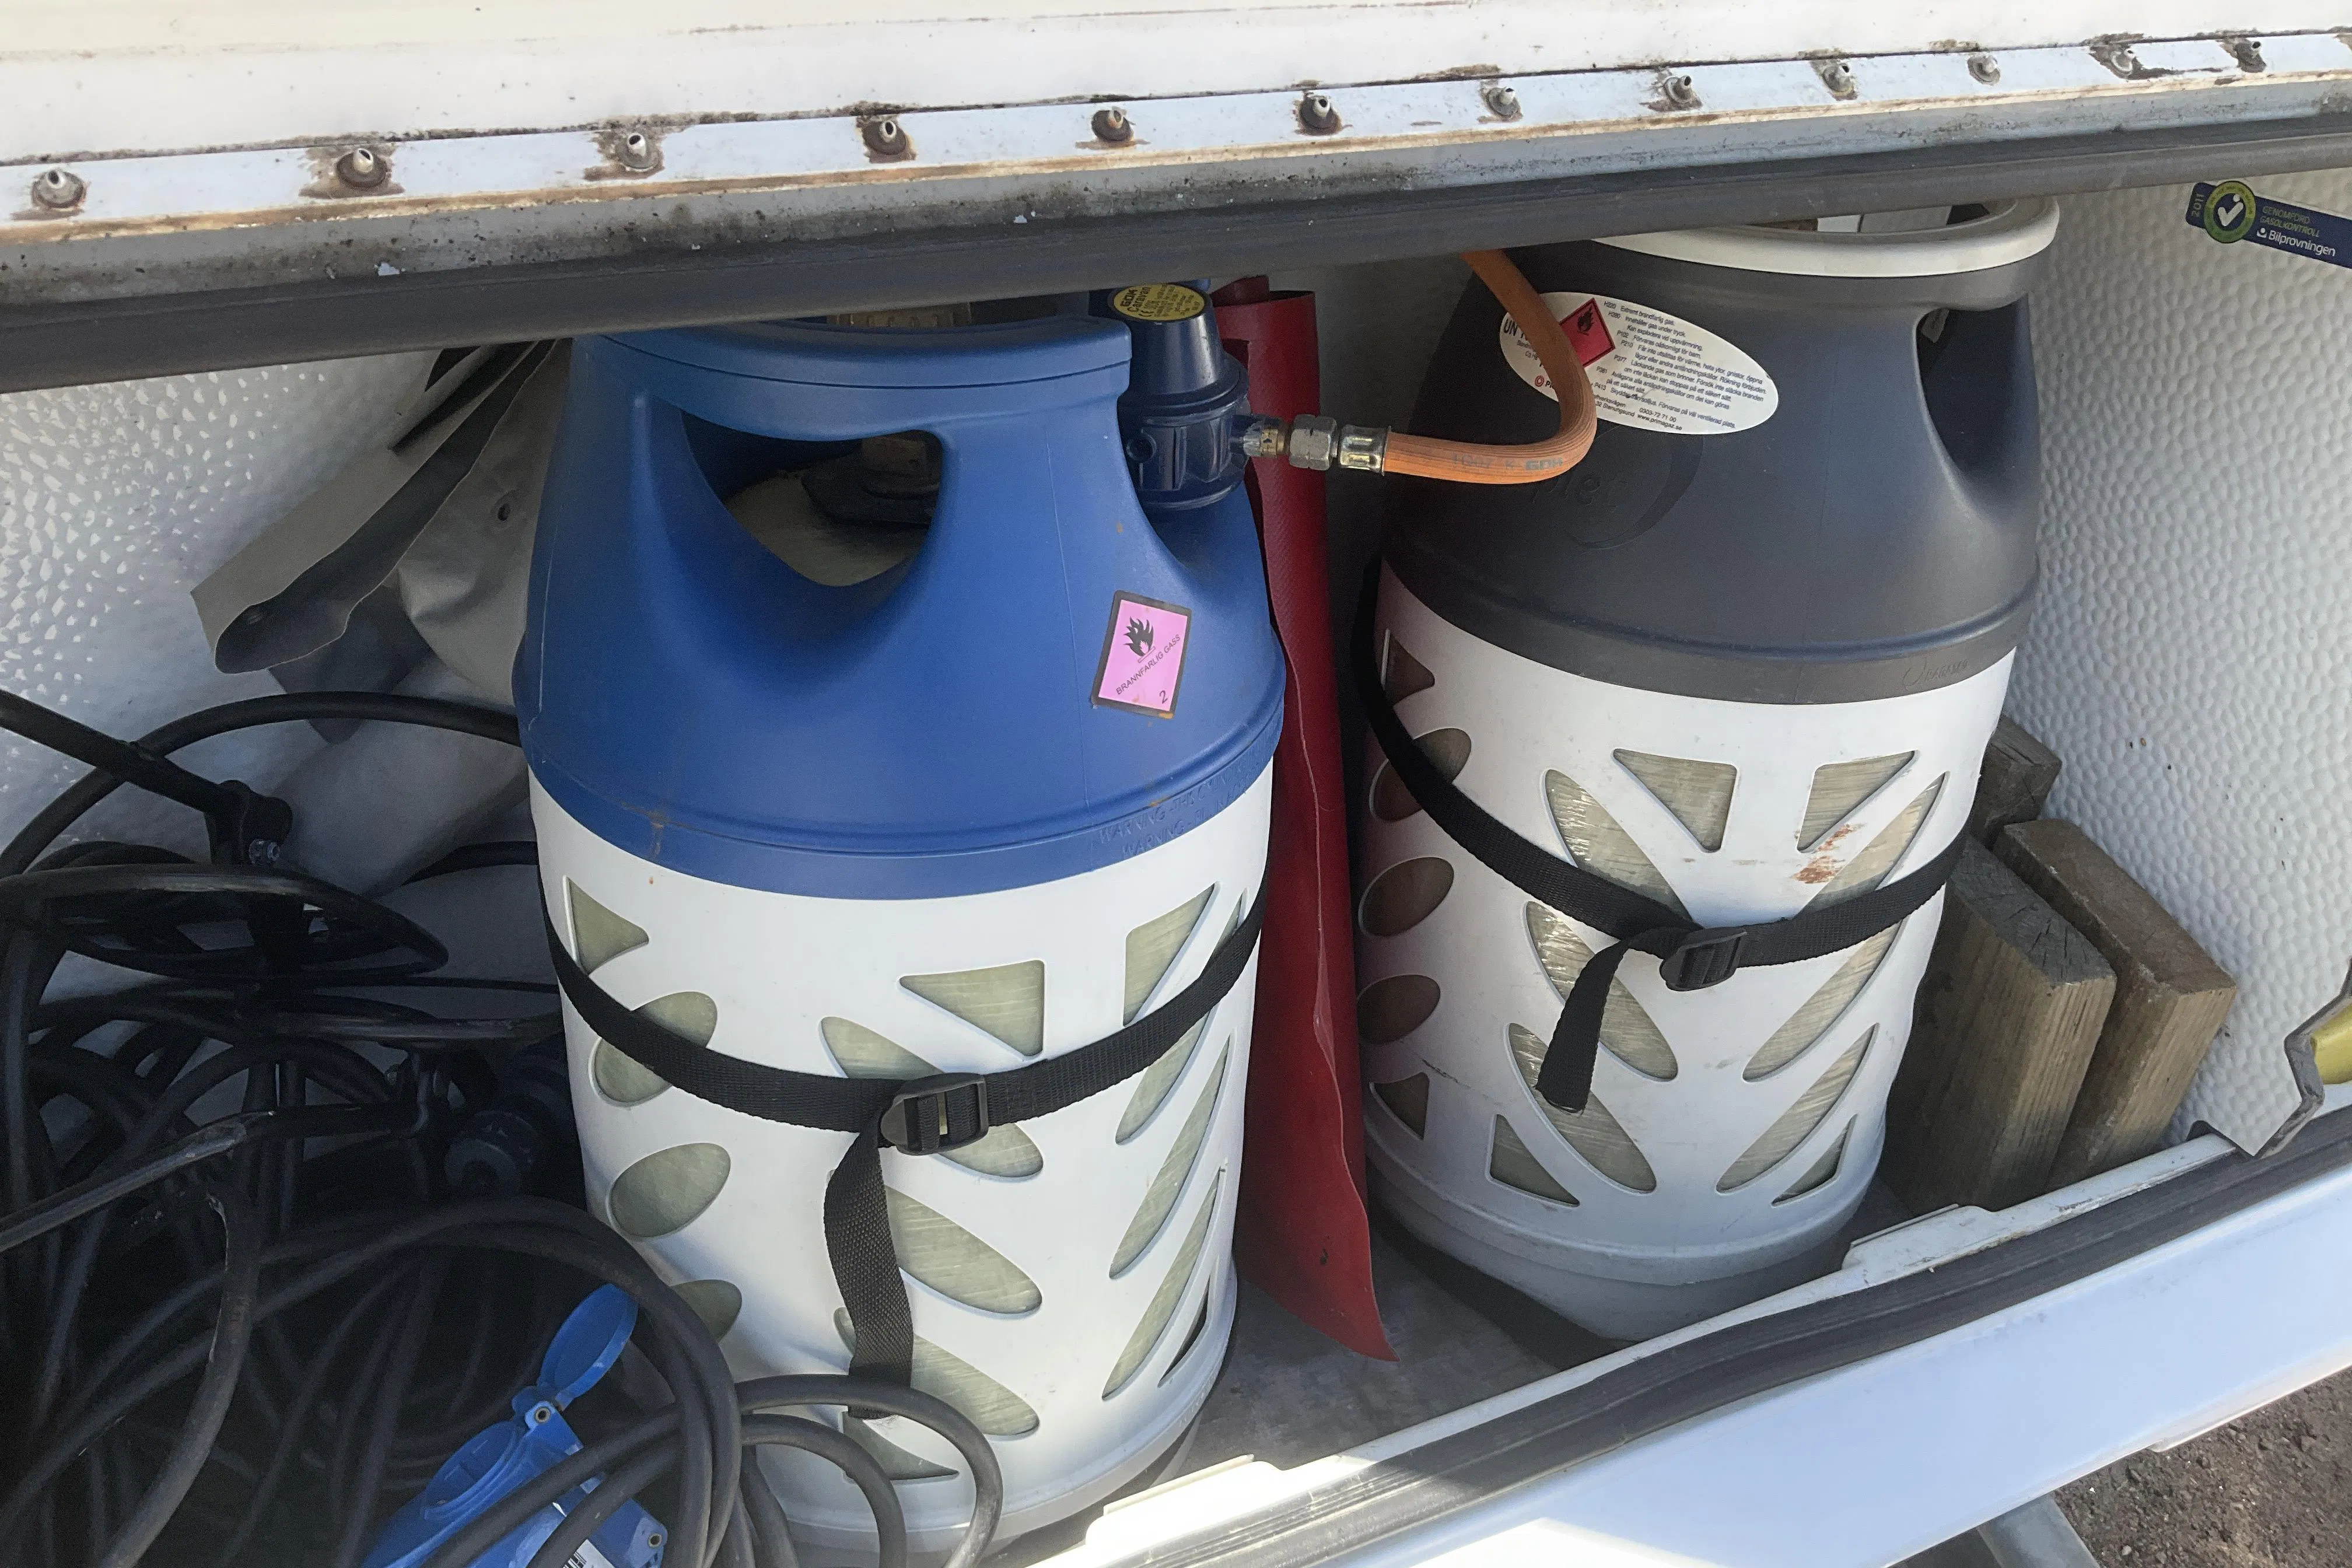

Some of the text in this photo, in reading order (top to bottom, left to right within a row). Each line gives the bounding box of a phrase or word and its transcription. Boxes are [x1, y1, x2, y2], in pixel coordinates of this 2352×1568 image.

[2269, 230, 2336, 257] Bilprovningen
[1503, 318, 1518, 336] UN
[1637, 414, 1682, 430] www.primagaz.se
[1116, 634, 1181, 695] BRANNFARLIG GASS
[1159, 690, 1168, 704] 2
